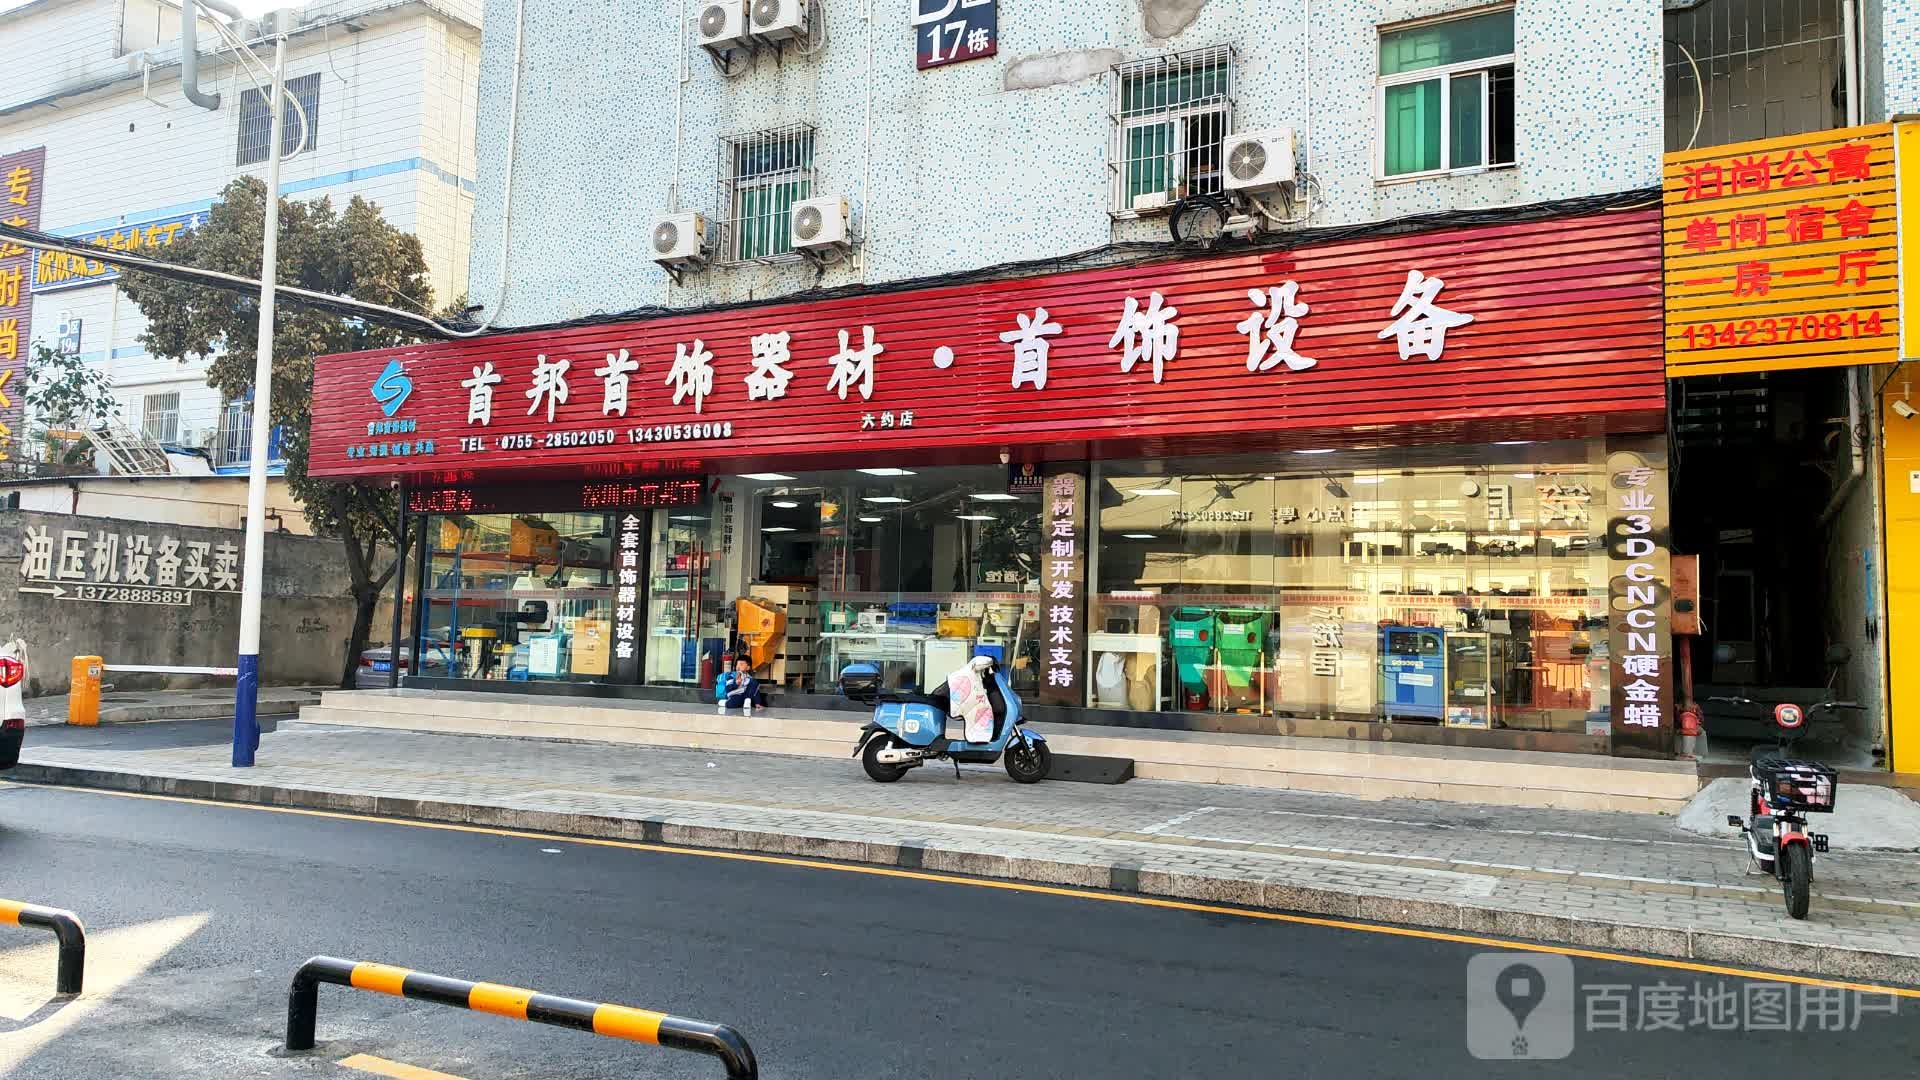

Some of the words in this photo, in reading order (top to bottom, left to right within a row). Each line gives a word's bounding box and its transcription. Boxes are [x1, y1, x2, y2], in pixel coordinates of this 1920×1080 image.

[926, 20, 989, 63] 17栋
[1683, 143, 1873, 201] 泊尚公寓
[1683, 250, 1878, 297] 一房一厅
[1682, 310, 1884, 350] 1342370814
[20, 525, 241, 592] 油压机设备买卖
[74, 585, 192, 604] 13728885891
[614, 514, 641, 659] 全套首饰器材设备
